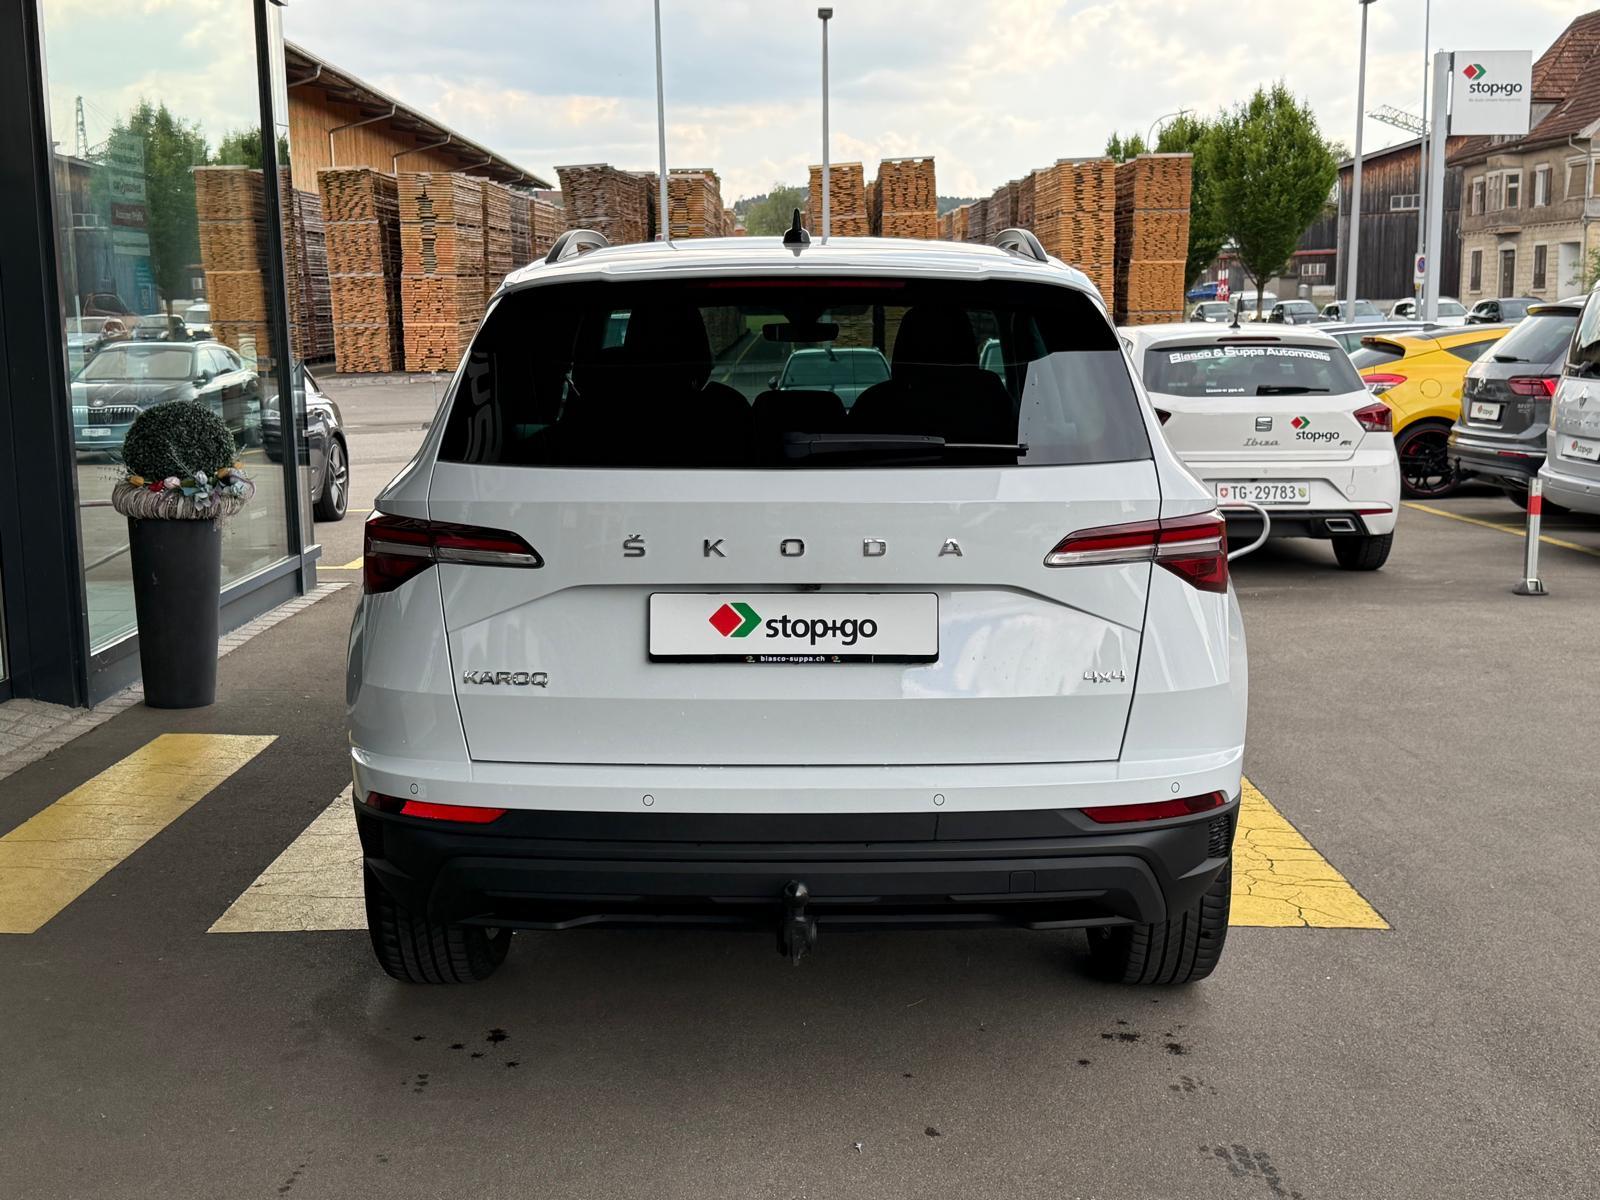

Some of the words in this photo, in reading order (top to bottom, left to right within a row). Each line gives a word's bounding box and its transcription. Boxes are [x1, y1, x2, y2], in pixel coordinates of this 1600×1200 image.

[1469, 82, 1522, 96] stop+go
[1214, 348, 1224, 357] &
[1224, 346, 1264, 358] Suppa
[1266, 348, 1331, 361] Automobile
[1296, 431, 1340, 442] stop+go
[765, 614, 878, 645] stop+go
[463, 670, 549, 688] KAROQ
